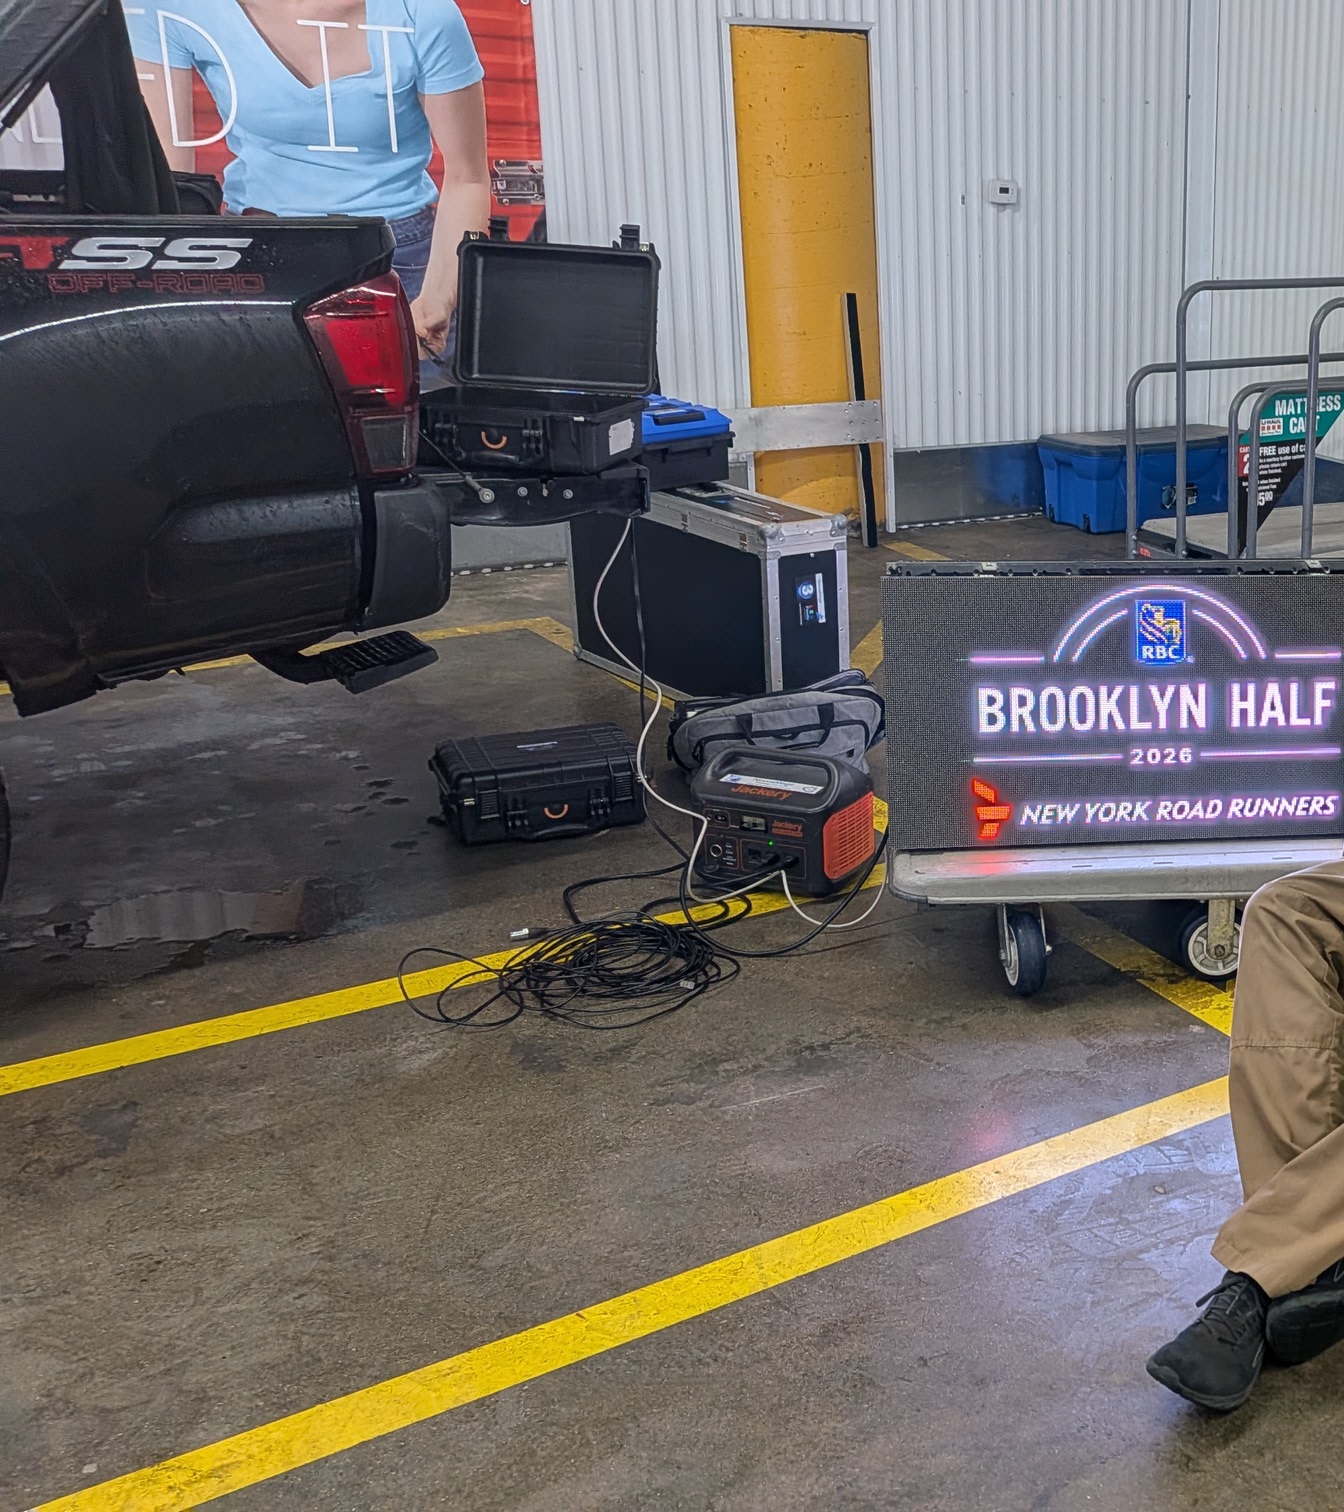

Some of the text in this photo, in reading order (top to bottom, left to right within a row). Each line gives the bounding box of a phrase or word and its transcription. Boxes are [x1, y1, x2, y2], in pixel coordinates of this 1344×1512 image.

[297, 19, 415, 153] IT
[48, 273, 265, 294] OFF-ROAD
[1275, 394, 1342, 417] MATTESS
[1289, 415, 1320, 434] CAT
[1259, 445, 1277, 457] FREE
[1277, 446, 1290, 455] use
[1291, 443, 1299, 453] of
[1141, 644, 1181, 660] RBC
[976, 680, 1337, 733] BROOKLYN HALF
[1129, 748, 1193, 765] 2026
[730, 784, 793, 800] Jackery
[1019, 795, 1340, 826] NEW YORK ROAD RUNNERS
[772, 820, 803, 833] Jackery
